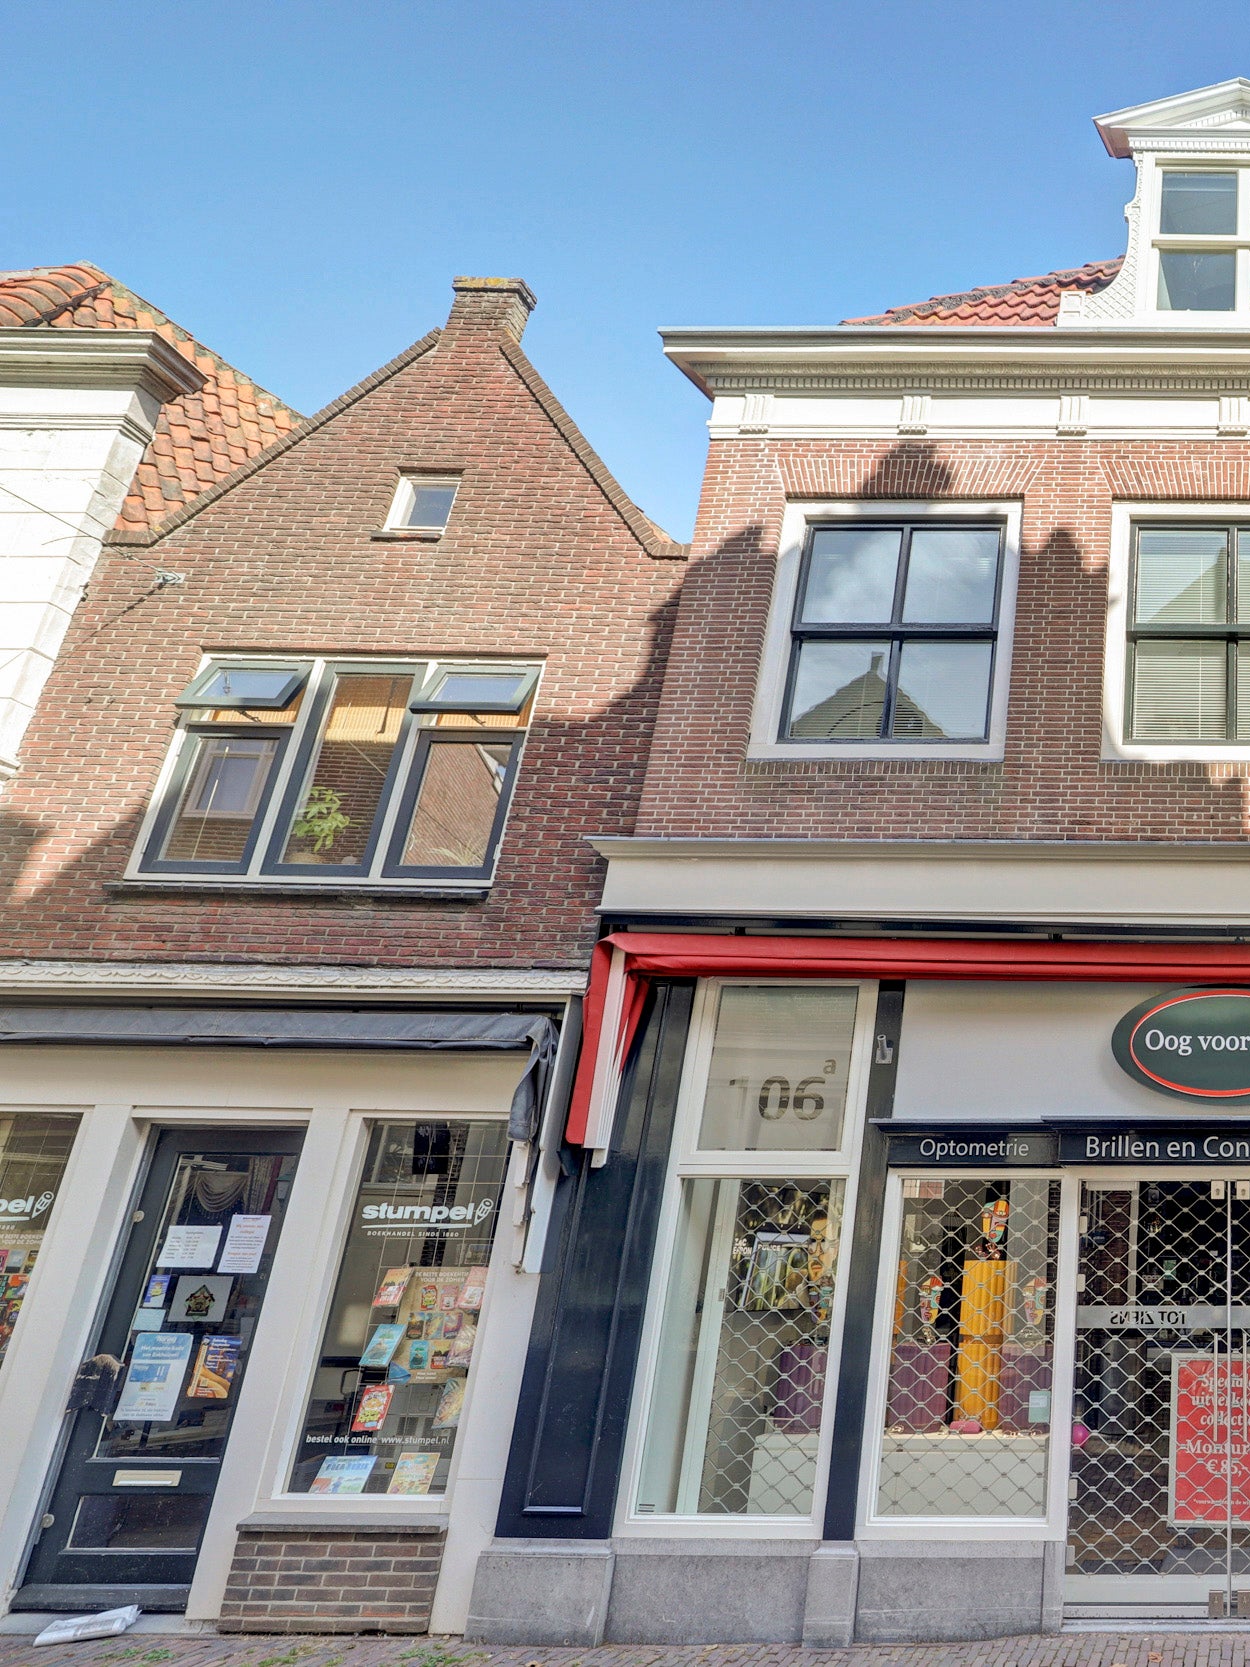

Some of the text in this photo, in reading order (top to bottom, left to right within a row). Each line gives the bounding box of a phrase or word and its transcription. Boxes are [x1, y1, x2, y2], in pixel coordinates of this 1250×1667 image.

[1145, 1029, 1192, 1056] Oog
[1198, 1034, 1250, 1051] voor
[919, 1138, 1030, 1160] Optometrie
[1085, 1136, 1159, 1158] Brillen
[1166, 1140, 1196, 1158] en
[361, 1202, 475, 1223] stumpel
[367, 1230, 415, 1238] BOEKHANDEL
[306, 1434, 449, 1446] bestel ook online www.stumpel.nl
